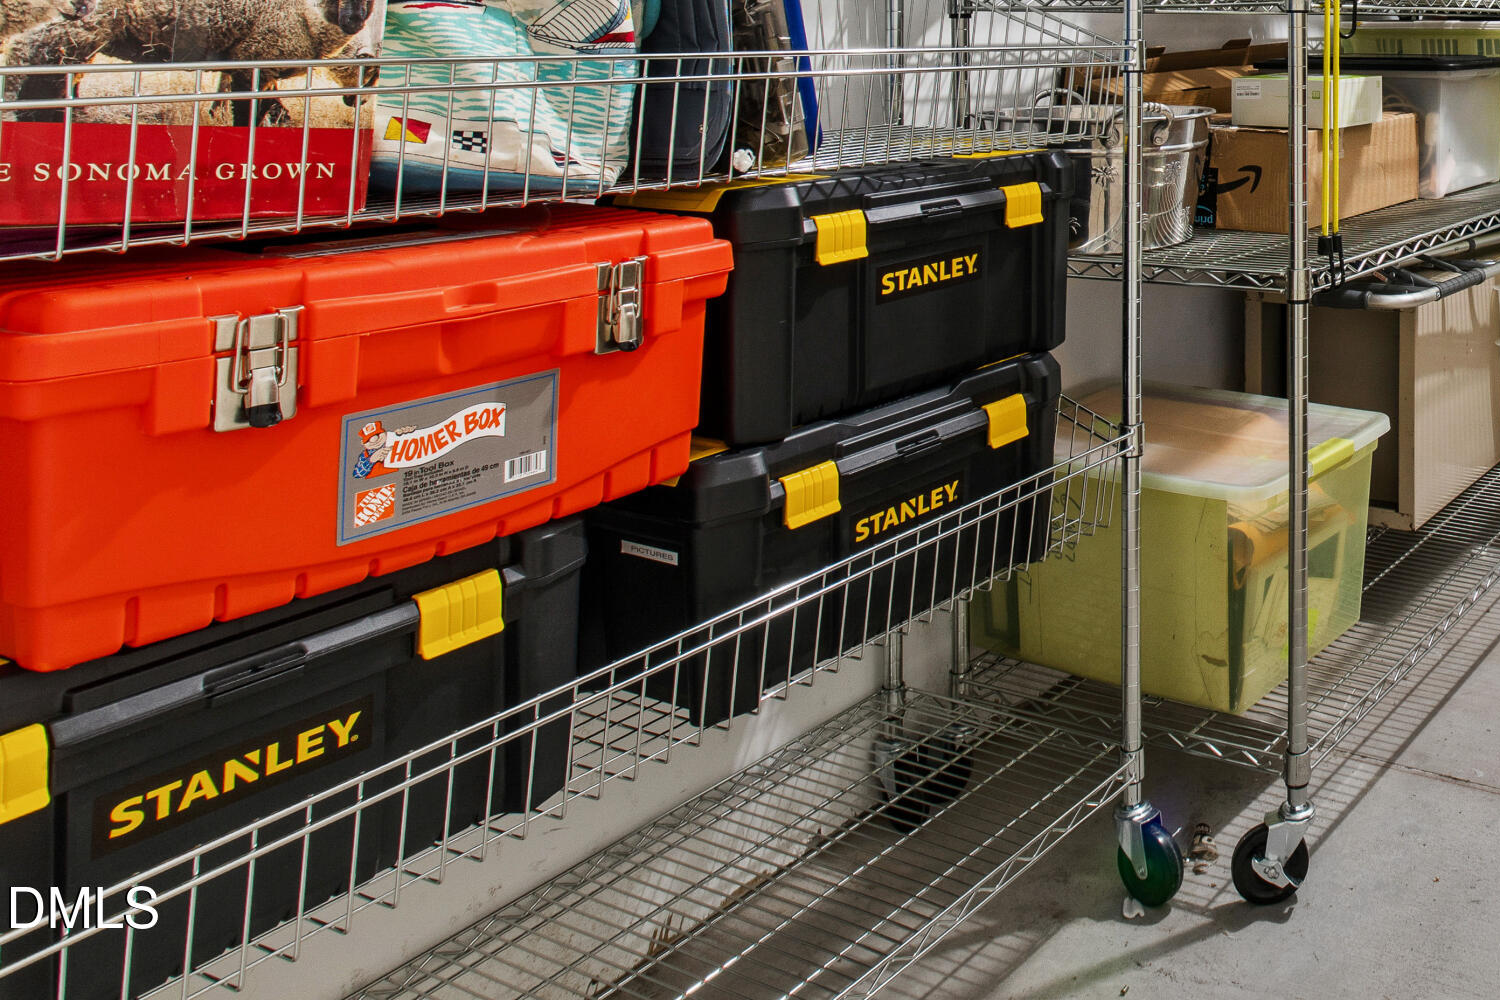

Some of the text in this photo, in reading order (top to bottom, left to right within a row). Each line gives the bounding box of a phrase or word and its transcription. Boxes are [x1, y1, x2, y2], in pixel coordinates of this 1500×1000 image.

[33, 162, 199, 182] SONOMA
[215, 162, 336, 180] GROWN
[881, 253, 978, 295] STANLEY
[390, 407, 506, 464] HOMER BOX
[420, 464, 437, 473] Tool
[438, 460, 455, 469] Box
[429, 470, 471, 486] heramientas
[354, 486, 396, 527] HOME
[855, 480, 959, 543] STANLEY
[108, 711, 362, 840] STANLEY
